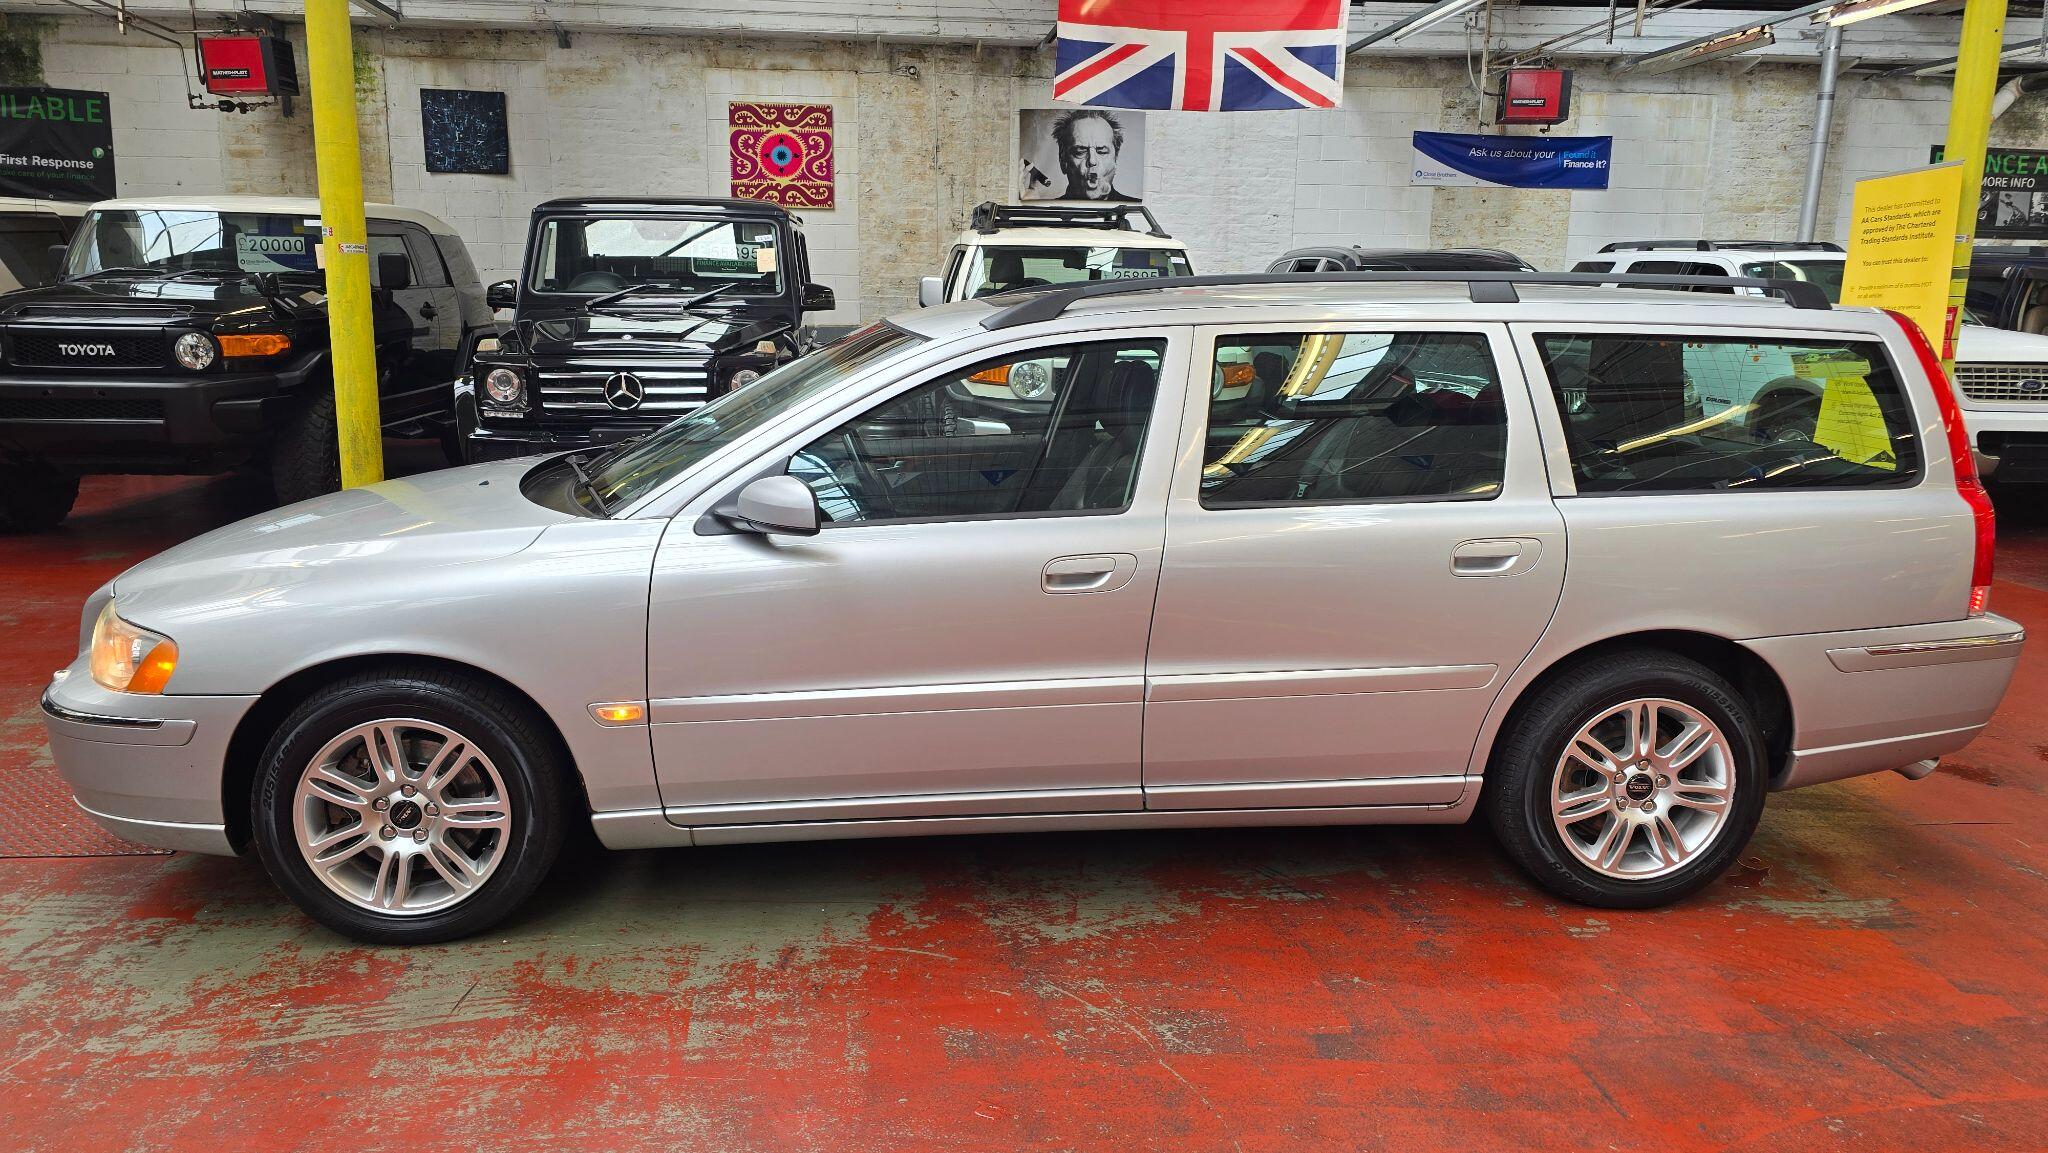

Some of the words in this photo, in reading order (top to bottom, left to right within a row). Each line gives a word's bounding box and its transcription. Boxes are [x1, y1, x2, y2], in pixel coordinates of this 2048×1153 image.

[1469, 147, 1487, 157] Ask
[1489, 149, 1502, 158] us
[1503, 149, 1532, 159] about
[1533, 151, 1555, 160] your
[1563, 151, 1589, 159] Found
[1590, 150, 1597, 159] it
[0, 154, 28, 166] First
[32, 155, 94, 169] Response
[1563, 160, 1595, 168] Finance
[1596, 160, 1607, 168] it?
[2010, 178, 2035, 188] INFO
[58, 344, 116, 356] TOYOTA
